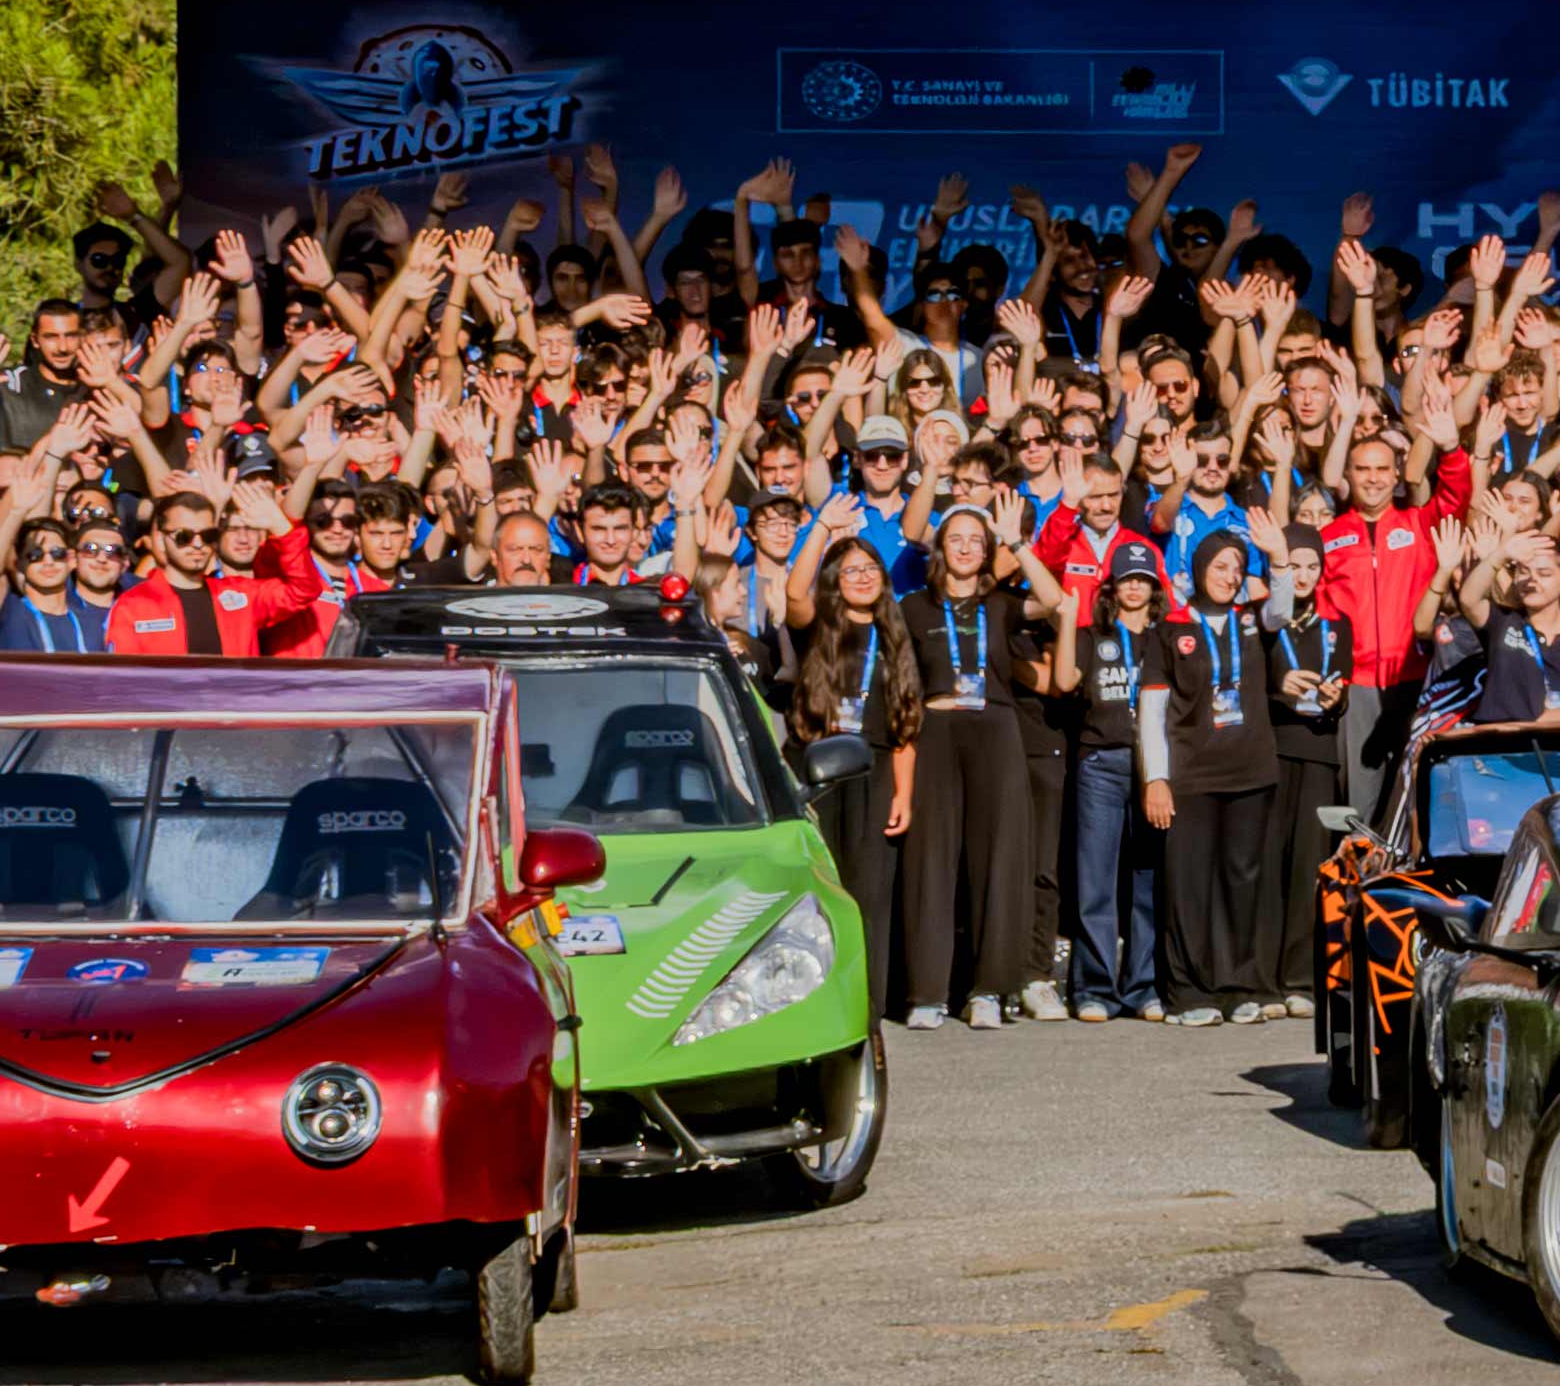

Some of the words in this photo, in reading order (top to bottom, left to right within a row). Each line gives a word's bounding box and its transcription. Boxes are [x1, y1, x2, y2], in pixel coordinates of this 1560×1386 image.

[1367, 73, 1512, 109] TÜBİTAK
[303, 95, 582, 180] TEKNOFEST
[319, 810, 406, 830] sparco
